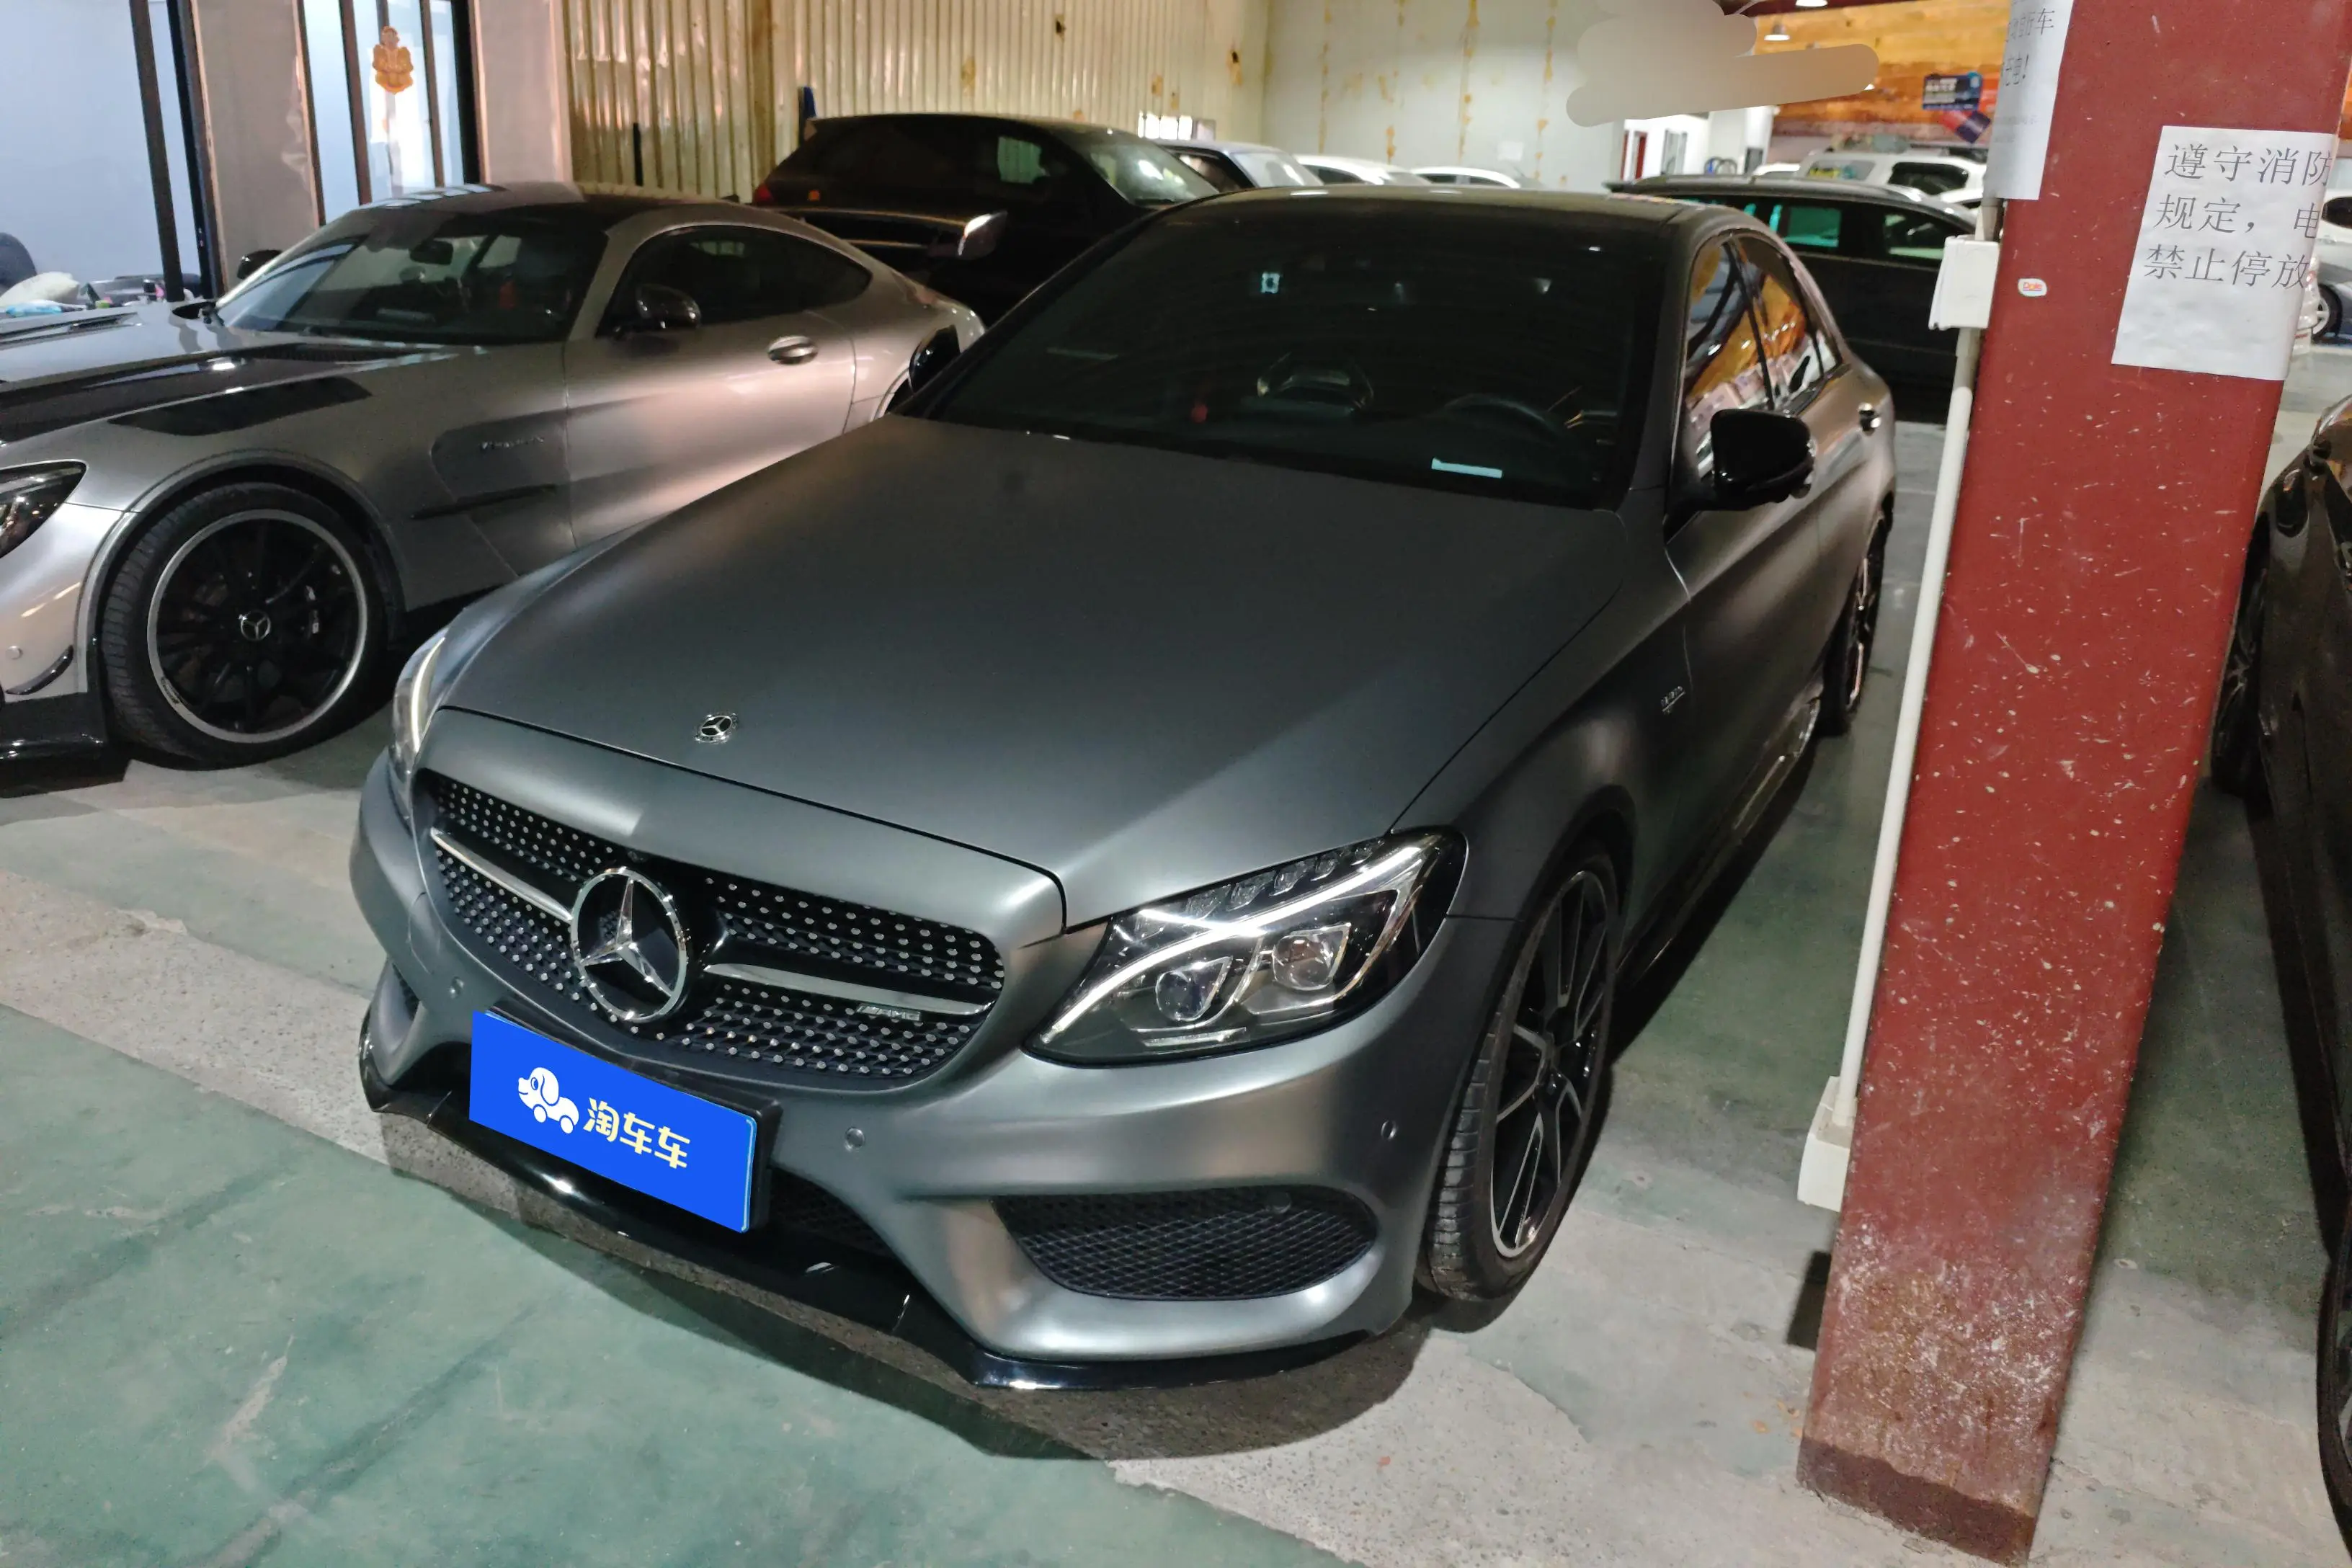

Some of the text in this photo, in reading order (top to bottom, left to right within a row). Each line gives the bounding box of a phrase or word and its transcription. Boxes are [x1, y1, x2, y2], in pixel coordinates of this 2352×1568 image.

[2164, 143, 2333, 186] 遵守消防
[2143, 244, 2309, 289] 禁止停放
